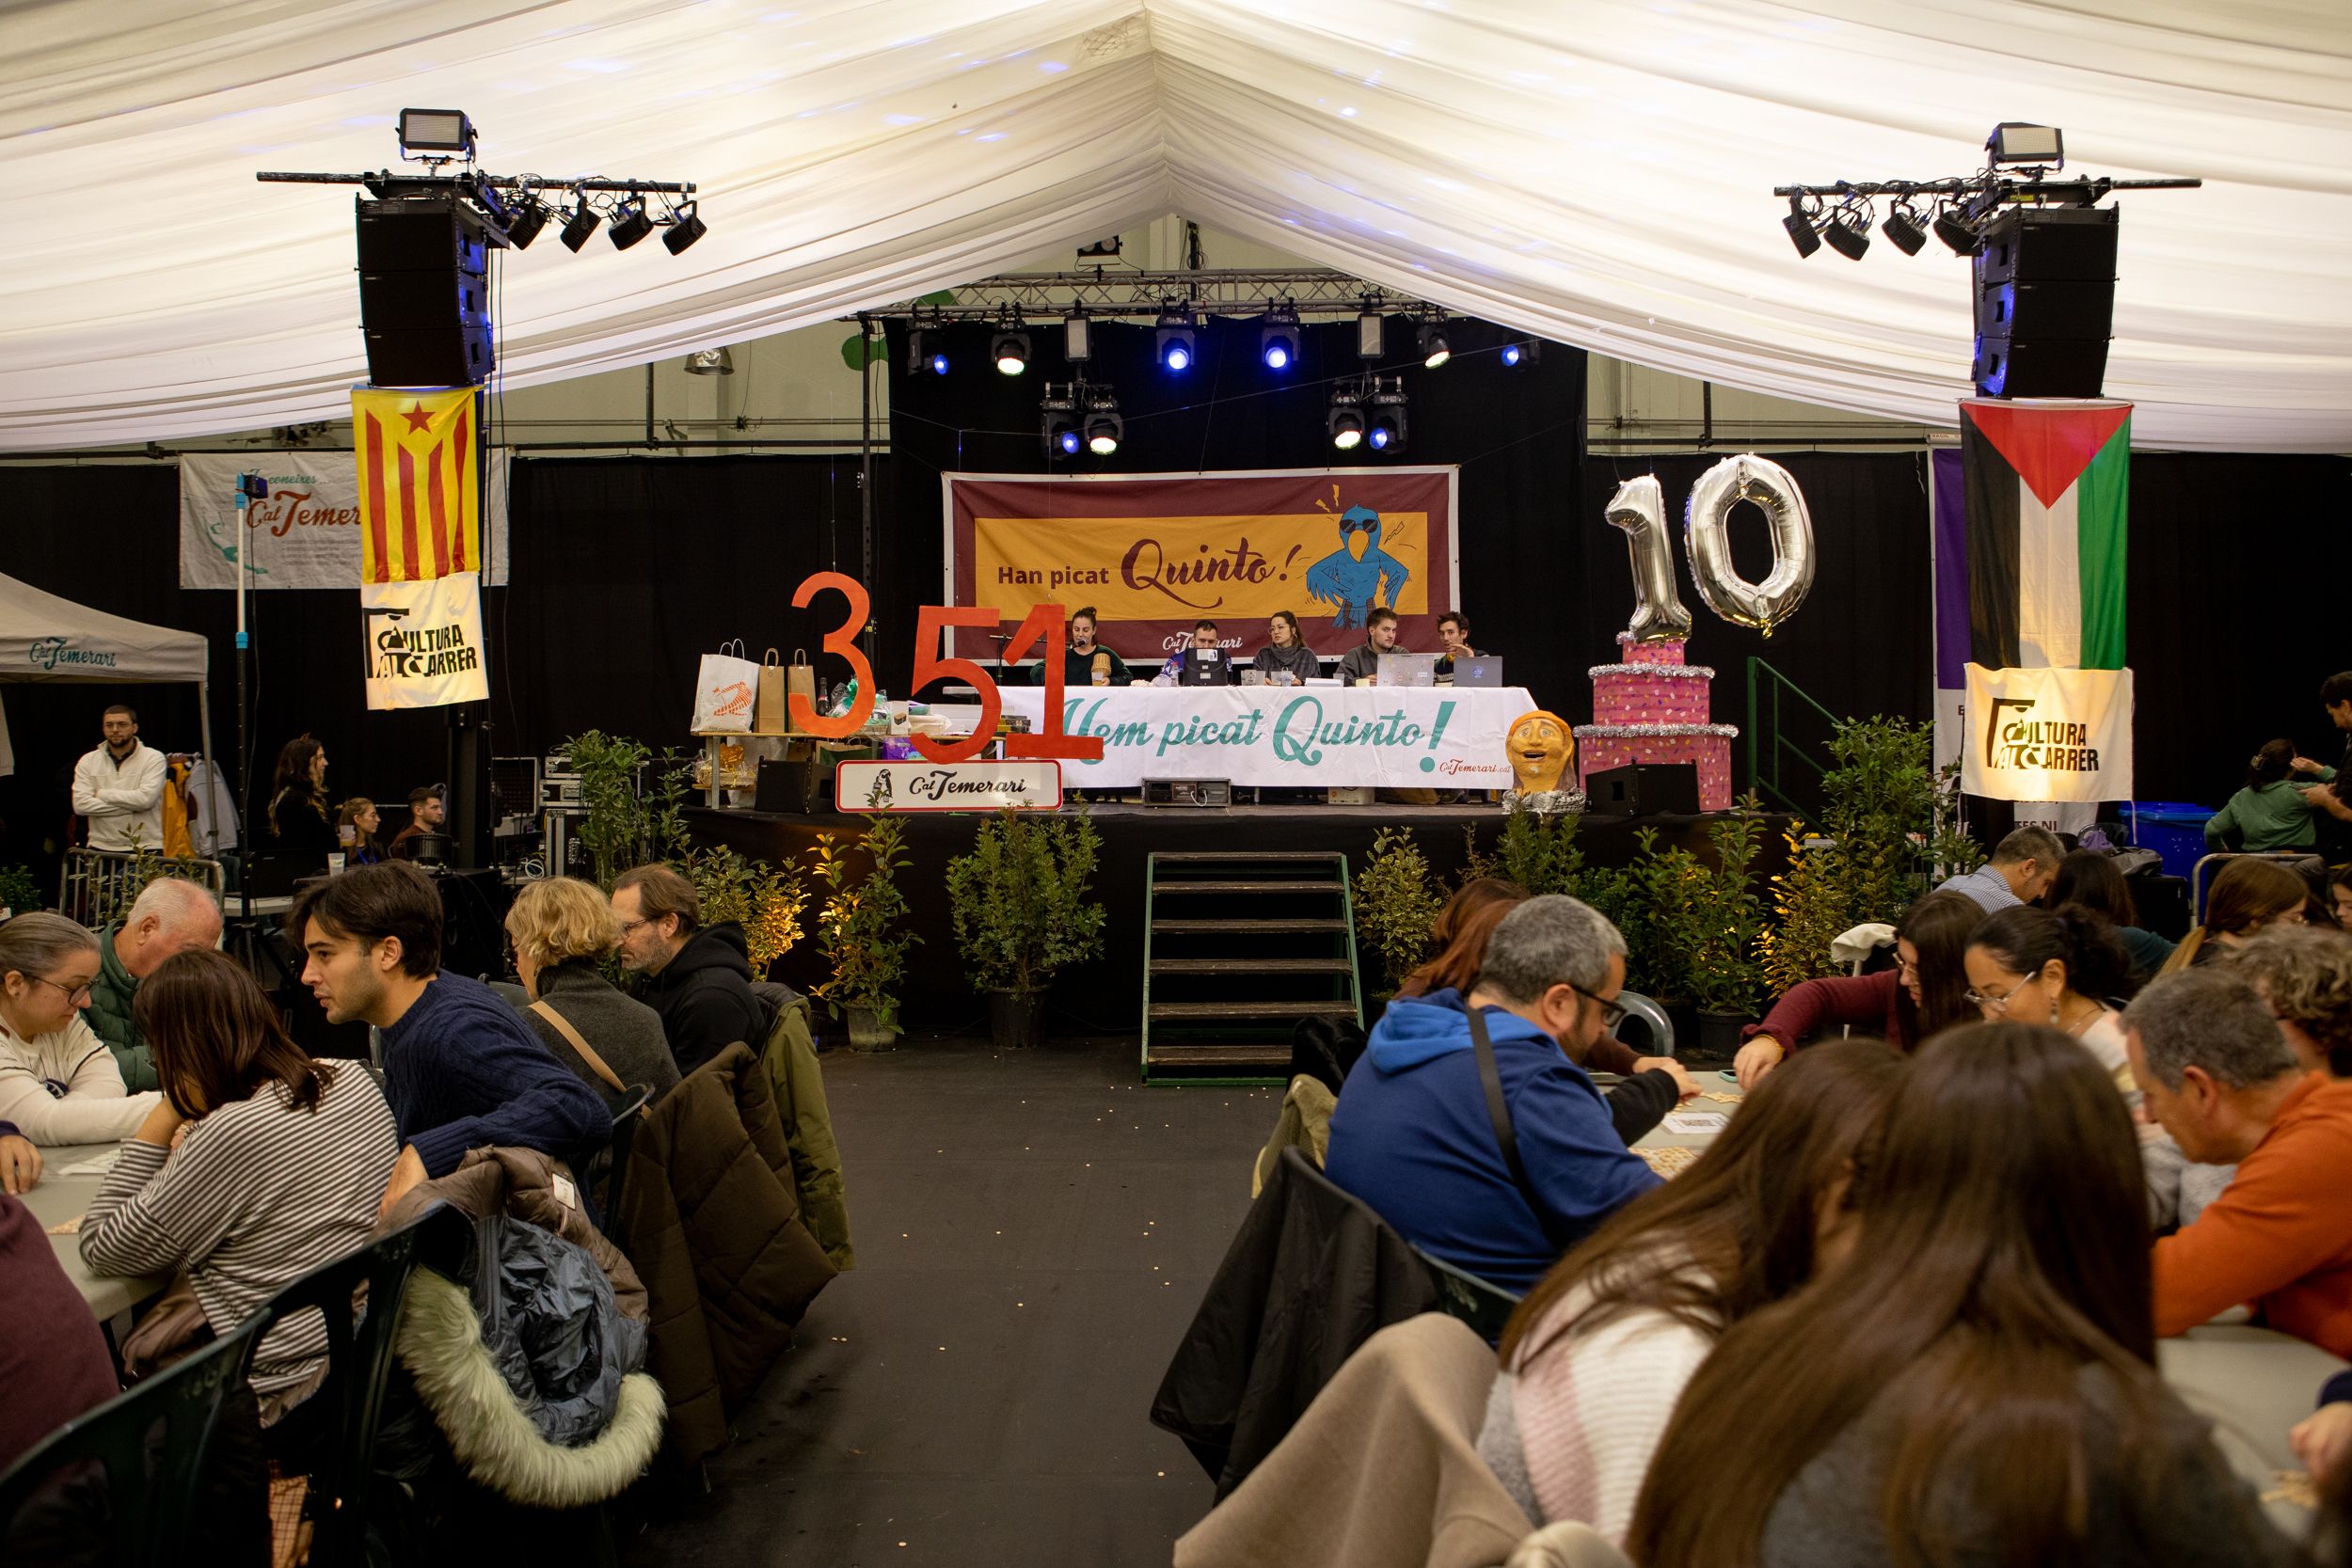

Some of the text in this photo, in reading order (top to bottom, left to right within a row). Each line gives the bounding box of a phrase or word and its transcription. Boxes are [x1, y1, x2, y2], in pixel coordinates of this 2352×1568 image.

[246, 490, 361, 537] Cal Temer
[998, 566, 1042, 585] Han
[1050, 565, 1109, 590] picat
[44, 637, 117, 670] Temerari
[1156, 708, 1264, 757] picat
[909, 769, 1026, 800] Cal Temerari
